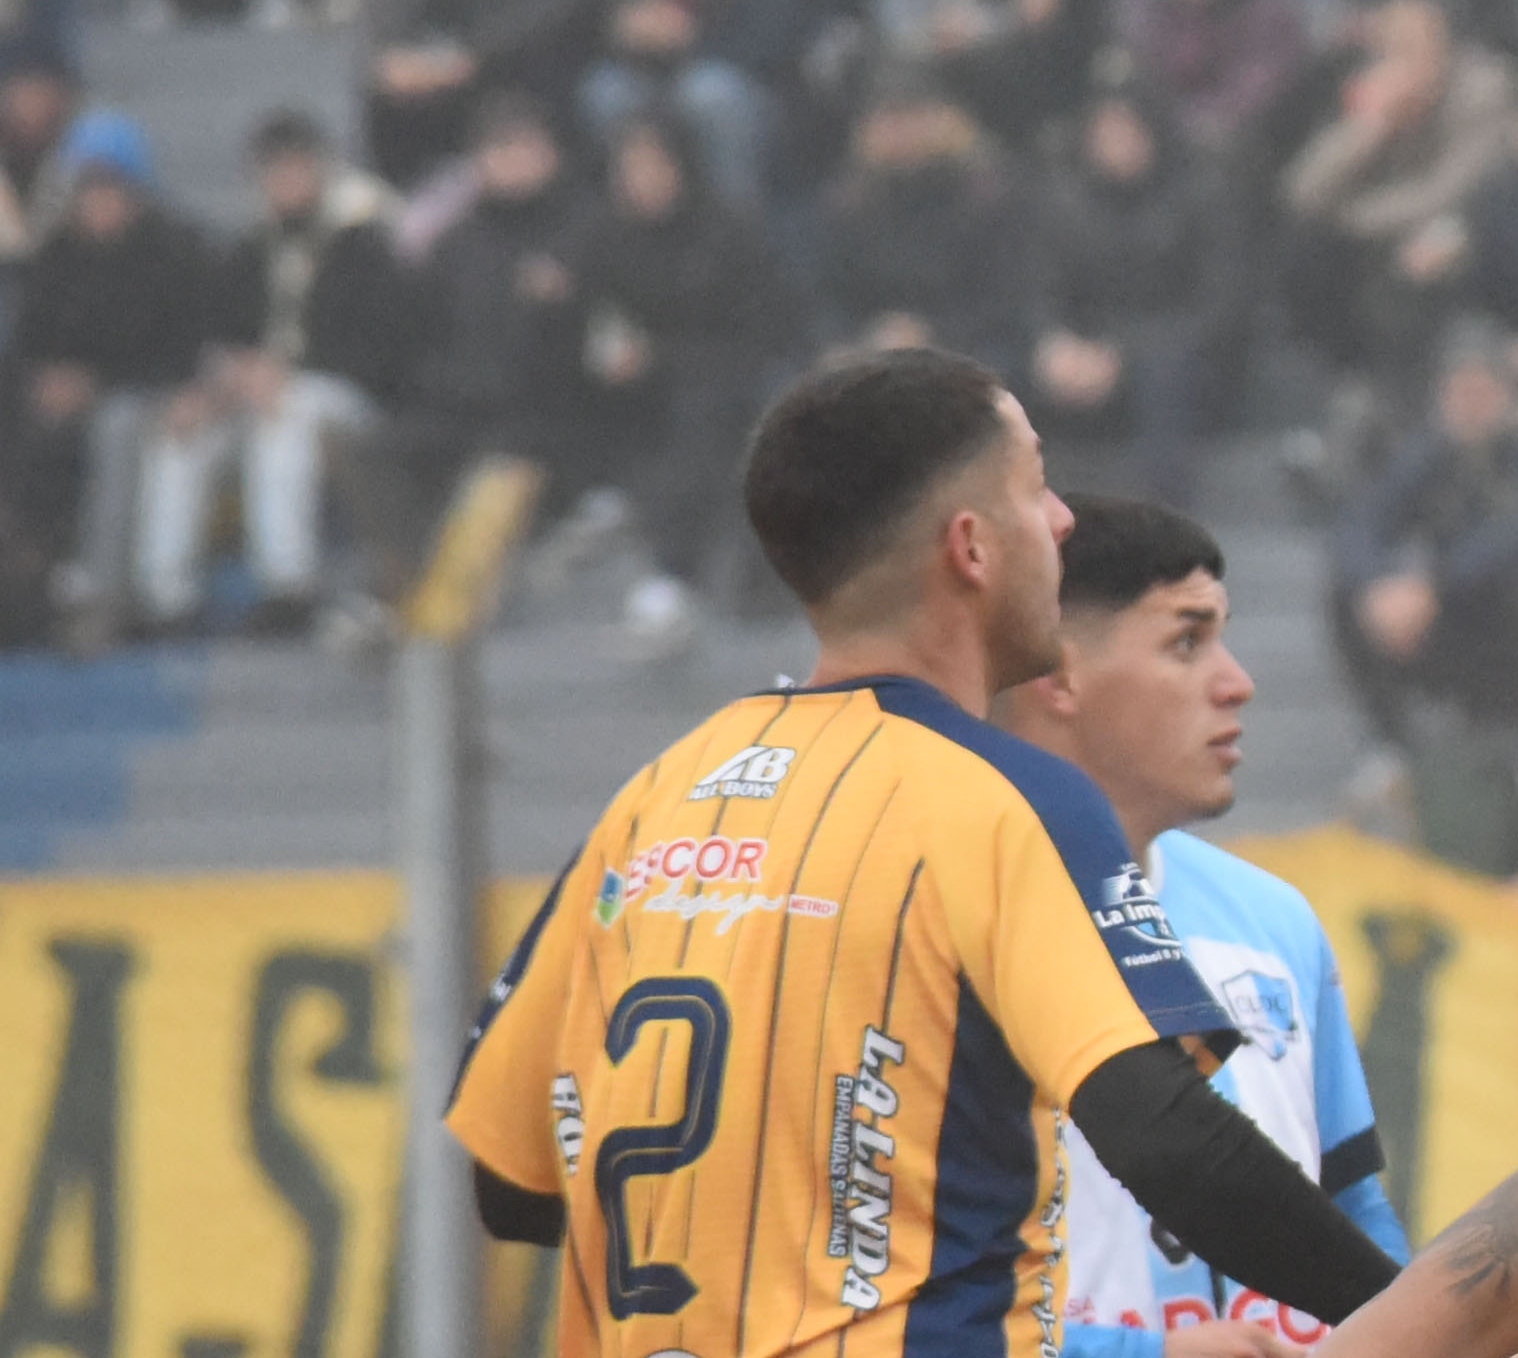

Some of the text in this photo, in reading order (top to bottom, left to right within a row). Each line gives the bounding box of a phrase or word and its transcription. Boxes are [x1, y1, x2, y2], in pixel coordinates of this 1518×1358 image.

[596, 976, 733, 1322] 2
[841, 1024, 905, 1311] LA LINDA
